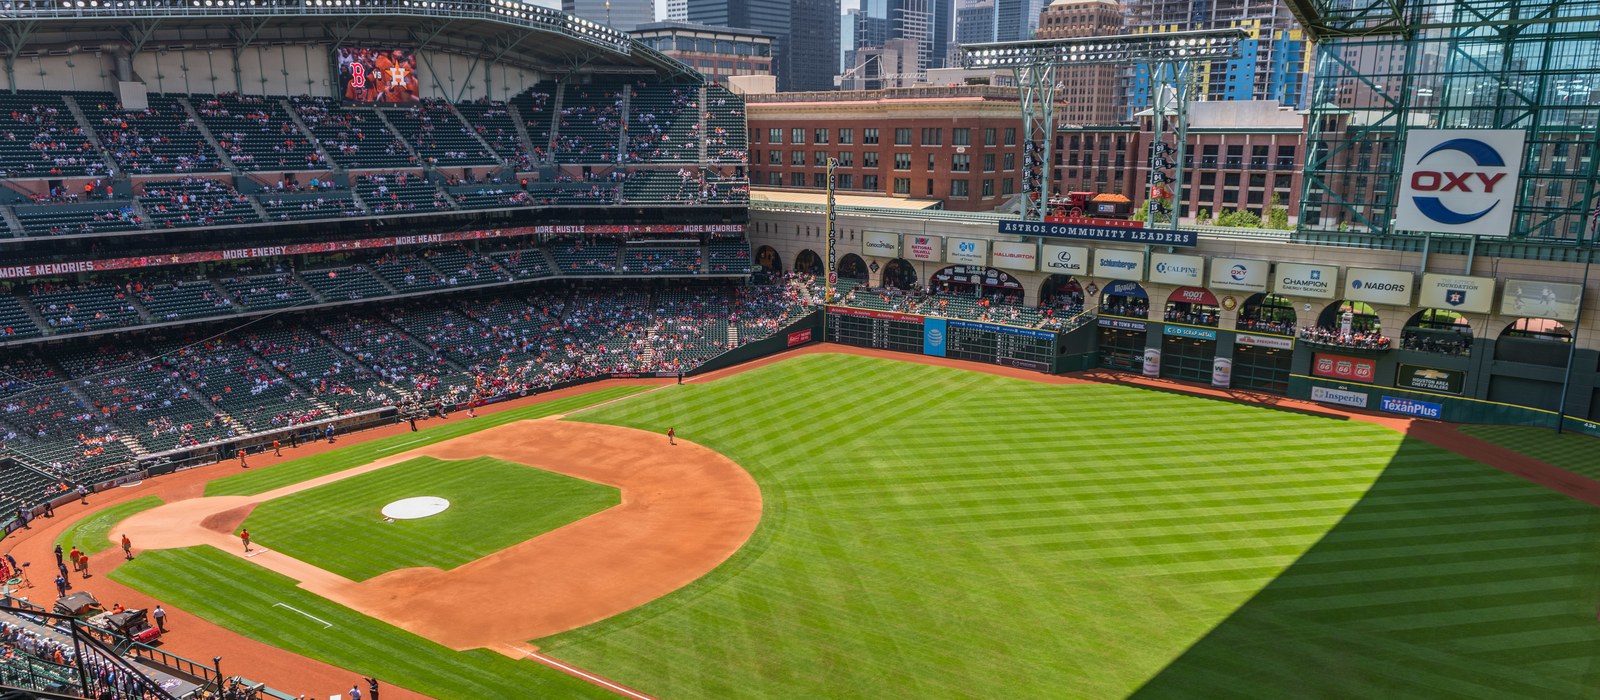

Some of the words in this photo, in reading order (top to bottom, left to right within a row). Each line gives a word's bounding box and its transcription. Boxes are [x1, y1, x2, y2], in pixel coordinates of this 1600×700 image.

[350, 62, 366, 87] B
[1410, 171, 1508, 193] OXY
[535, 225, 554, 233] MORE
[556, 225, 585, 233] HUSTLE
[1051, 226, 1126, 238] COMMUNITY
[1131, 231, 1189, 243] LEADERS
[395, 236, 416, 245] MORE
[418, 233, 442, 244] HEART
[866, 241, 895, 250] ConocoPhillips
[223, 249, 249, 260] MORE
[251, 245, 287, 257] ENERGY
[993, 252, 1035, 260] HALLIBURTON
[0, 266, 32, 278] MORE
[35, 260, 94, 275] MEMORIES
[1047, 261, 1080, 270] LEXUS
[1100, 258, 1138, 270] Schlumberger
[1167, 265, 1198, 274] CALPINE
[1283, 277, 1328, 288] CHAMPION
[1364, 281, 1405, 292] NABORS
[1437, 282, 1479, 290] FOUNDATION
[1183, 290, 1205, 298] ROOT
[1198, 330, 1213, 338] METAL
[1427, 383, 1448, 391] DEALERS
[1325, 391, 1365, 403] Insperity
[1383, 399, 1438, 417] TexanPlus
